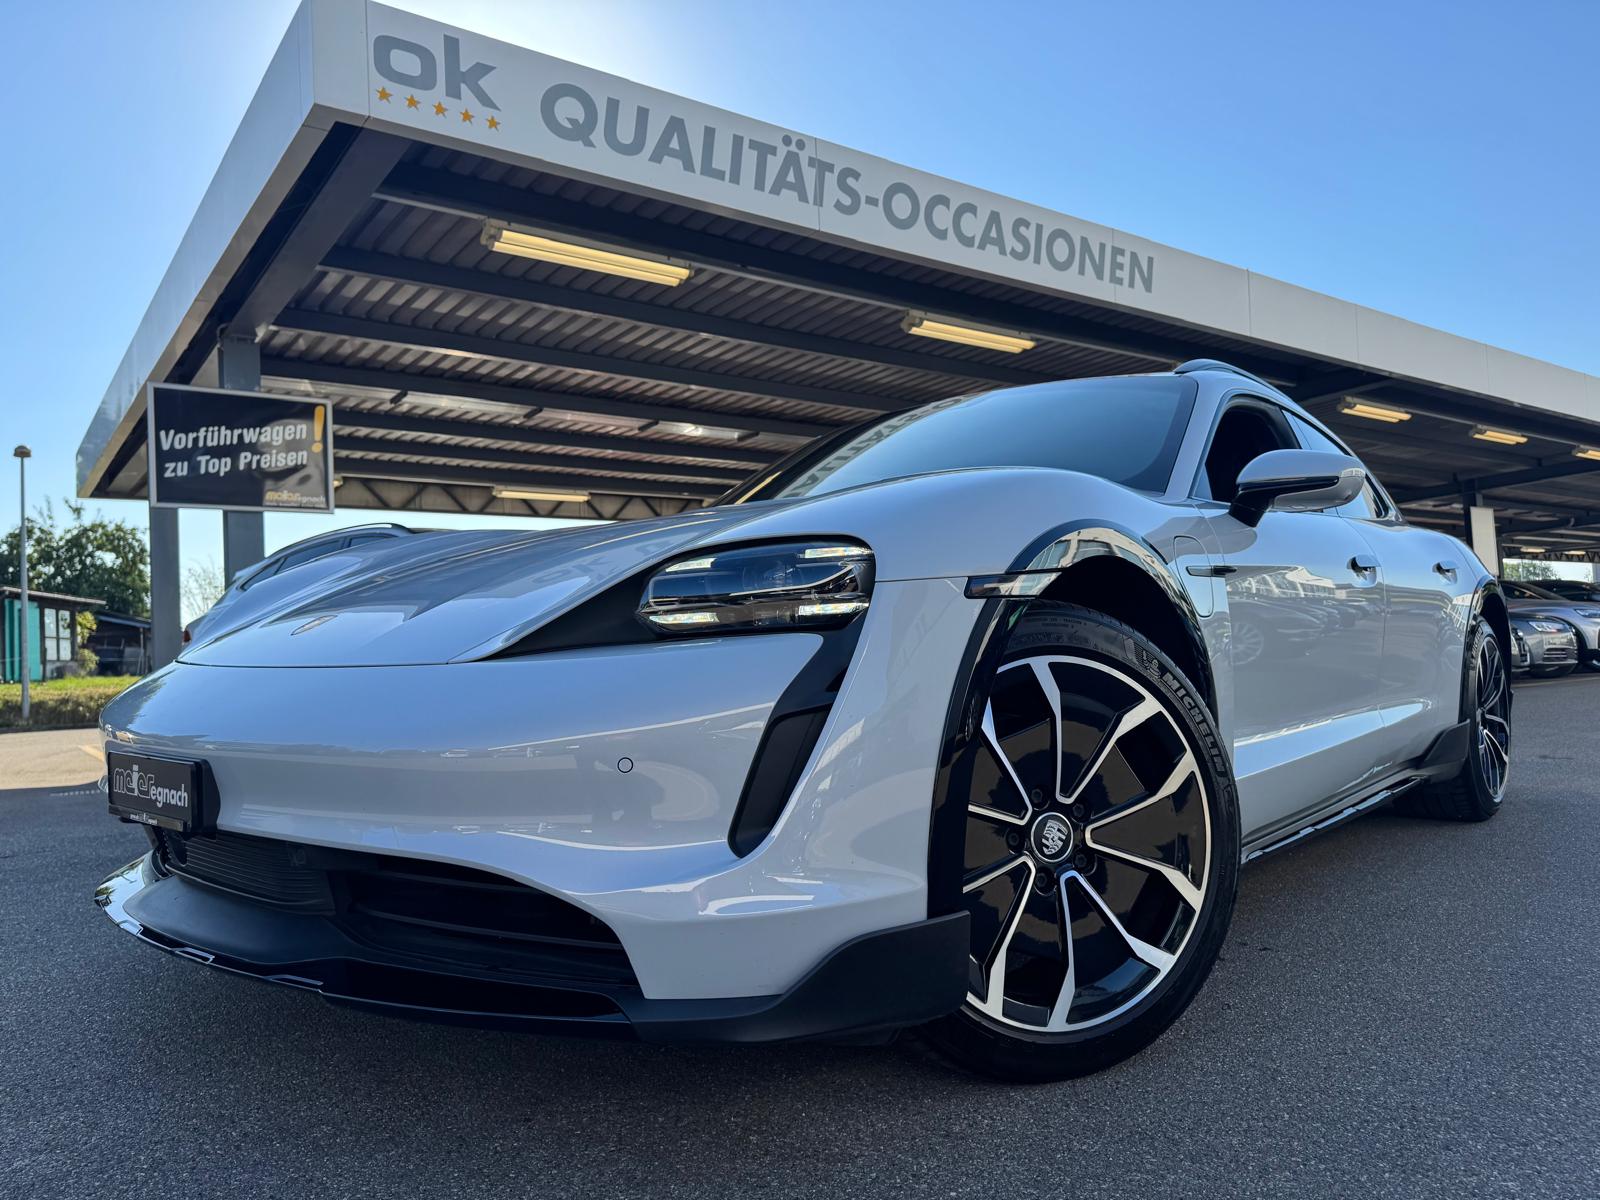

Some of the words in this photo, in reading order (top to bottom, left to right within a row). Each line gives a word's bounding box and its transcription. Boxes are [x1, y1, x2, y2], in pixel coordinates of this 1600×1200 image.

[373, 34, 501, 112] ok
[540, 83, 1154, 293] QUALITÄTS-OCCASIONEN
[159, 423, 307, 451] Vorführwagen
[164, 461, 188, 478] zu
[197, 455, 231, 477] Top
[239, 450, 307, 471] Preisen
[1162, 672, 1226, 772] MICHELIN
